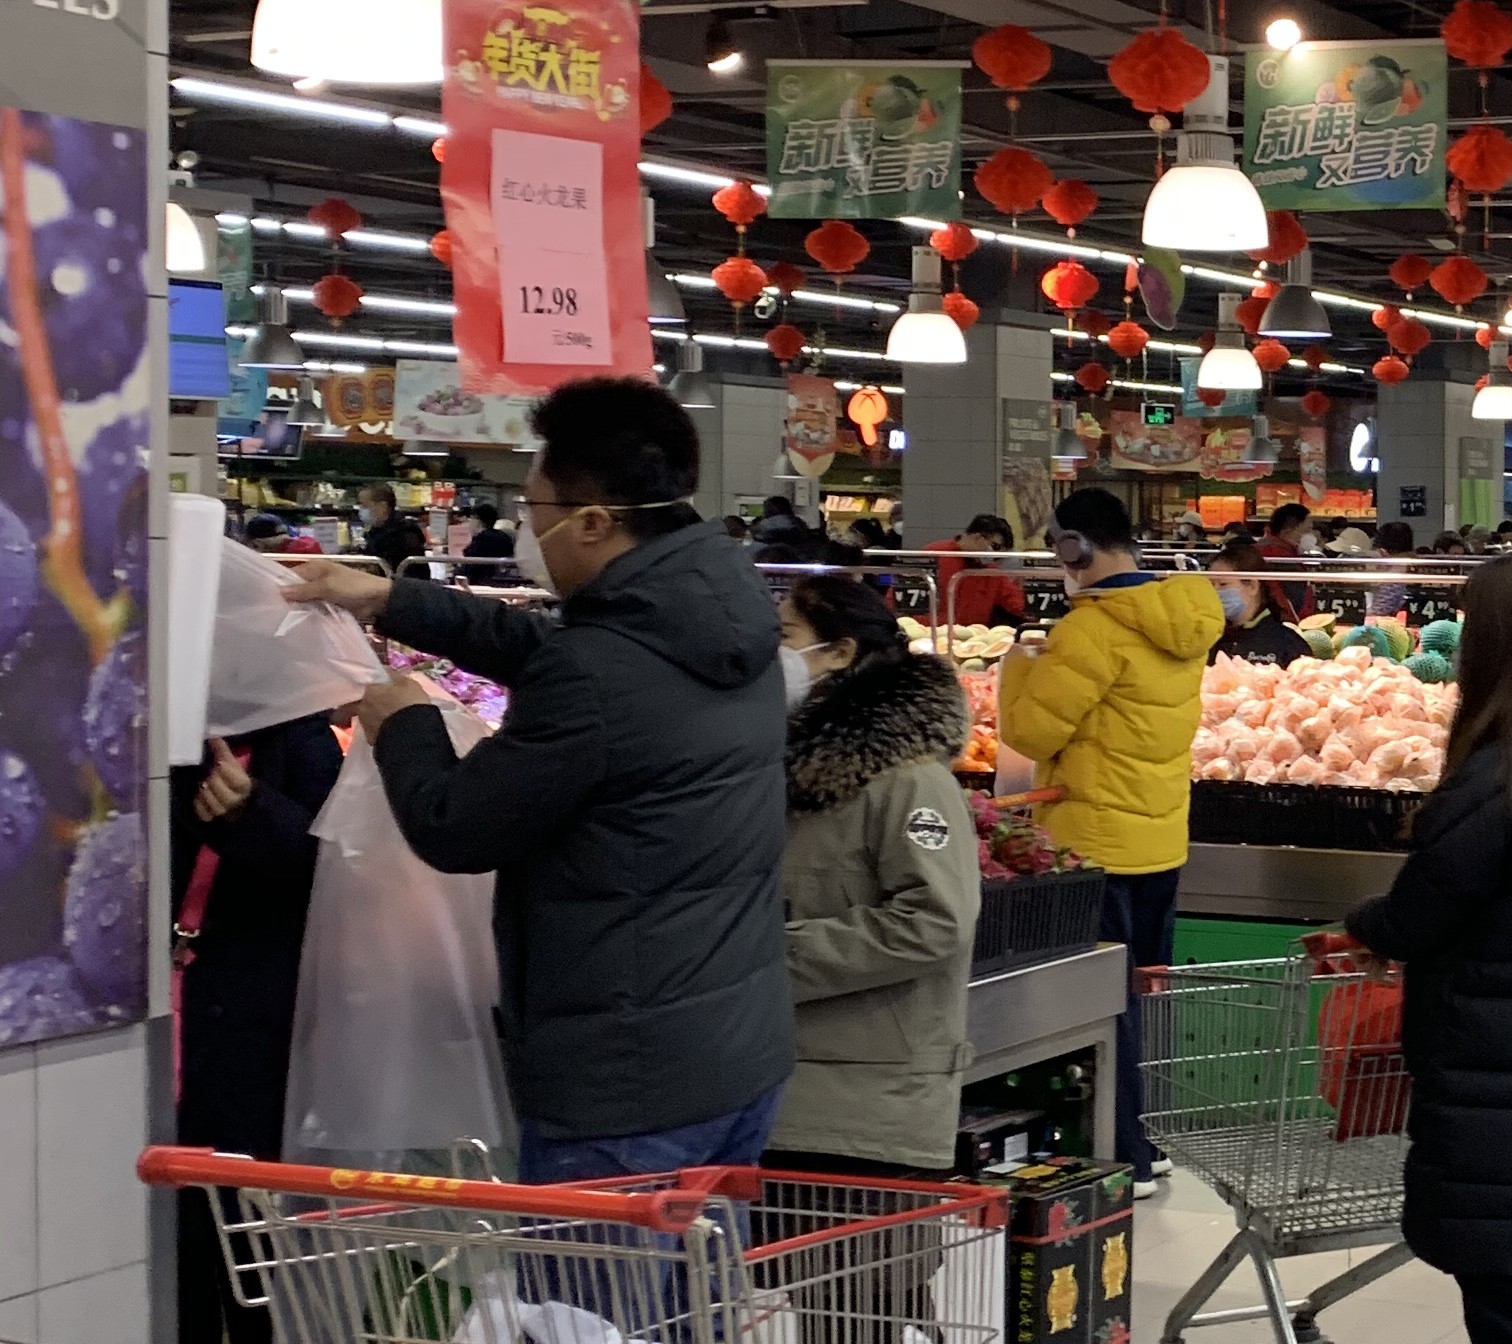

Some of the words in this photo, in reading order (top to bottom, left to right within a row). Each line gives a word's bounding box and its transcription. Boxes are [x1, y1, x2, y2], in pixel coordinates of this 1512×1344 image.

[482, 28, 601, 102] 年货大街
[1253, 102, 1356, 164] 新鲜
[1315, 123, 1438, 189] 又营养
[520, 285, 578, 316] 12.98
